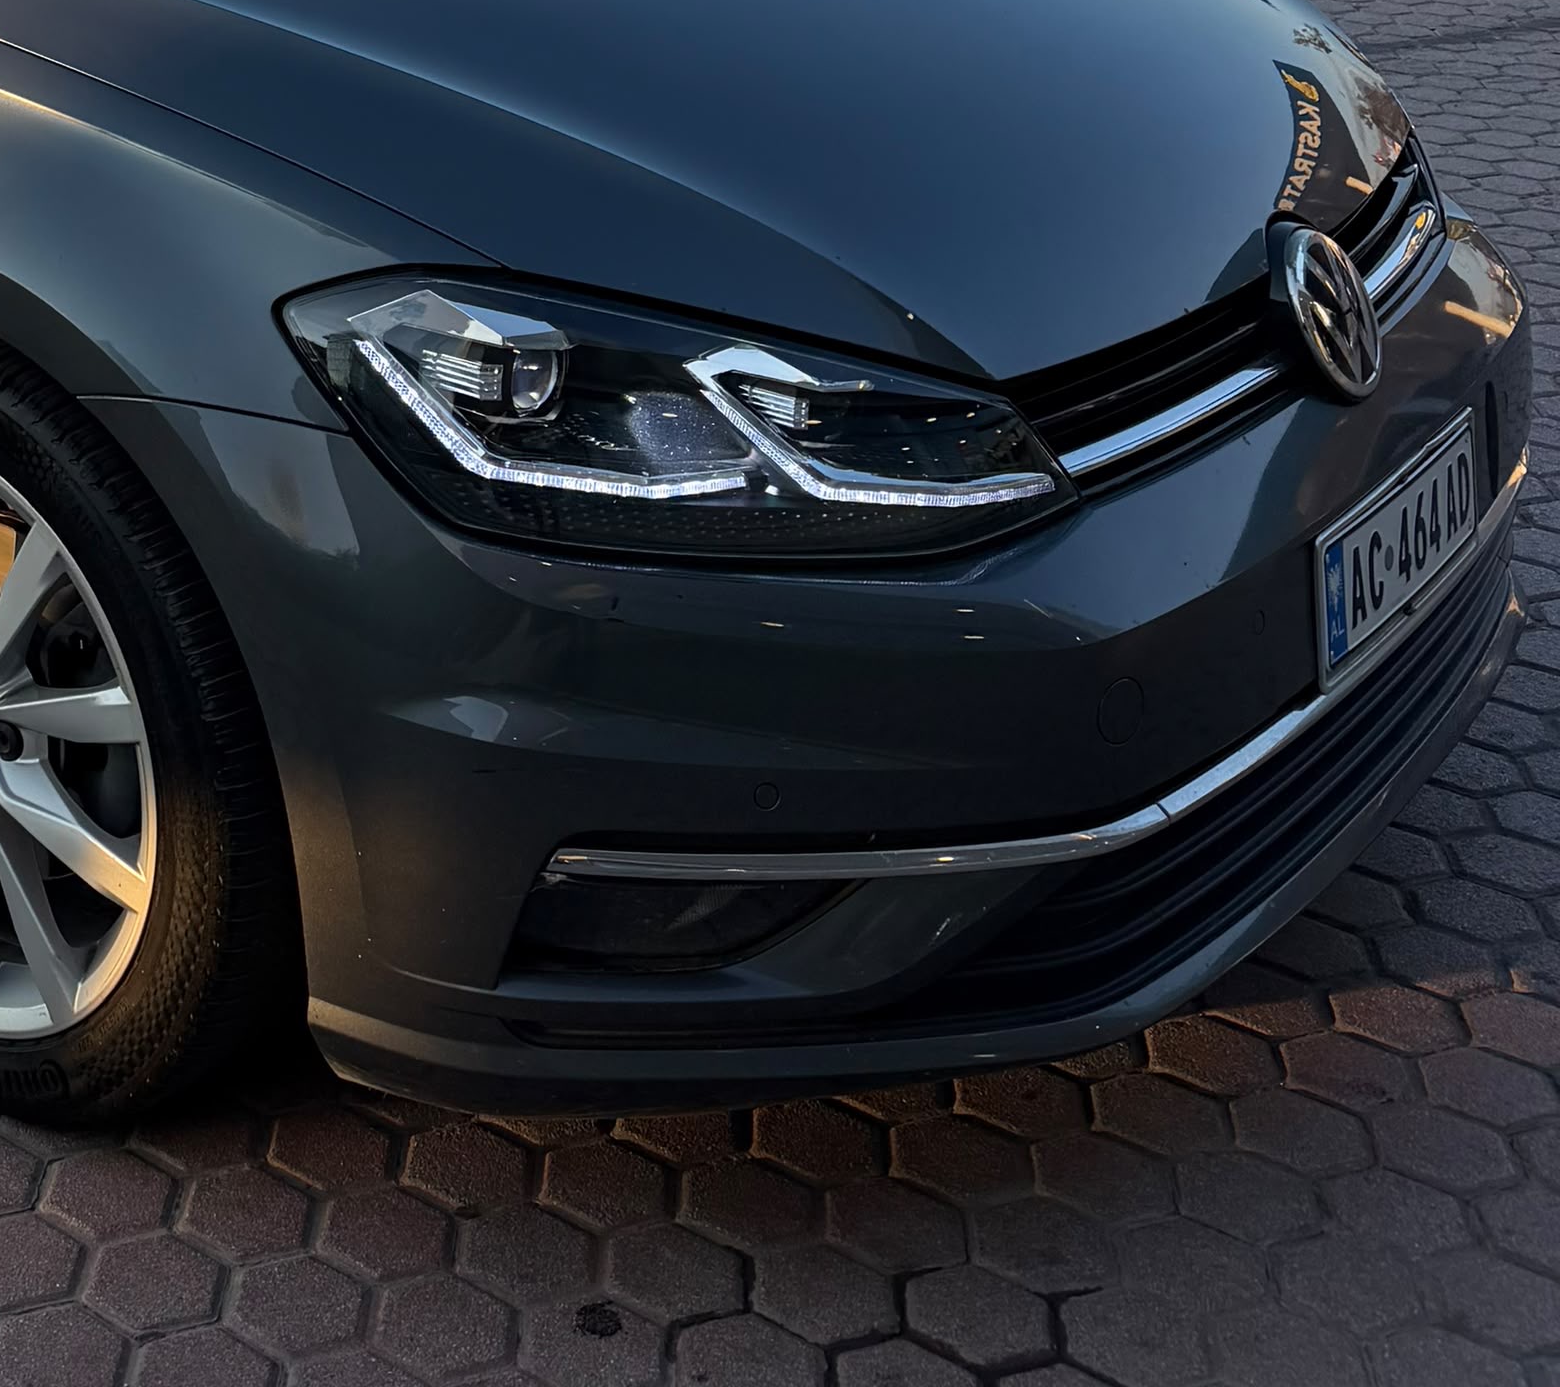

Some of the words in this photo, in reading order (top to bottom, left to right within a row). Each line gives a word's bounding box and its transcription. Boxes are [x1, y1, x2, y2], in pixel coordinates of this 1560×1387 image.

[1351, 530, 1385, 630] AC
[1398, 477, 1441, 584] 464
[1446, 453, 1470, 544] AD
